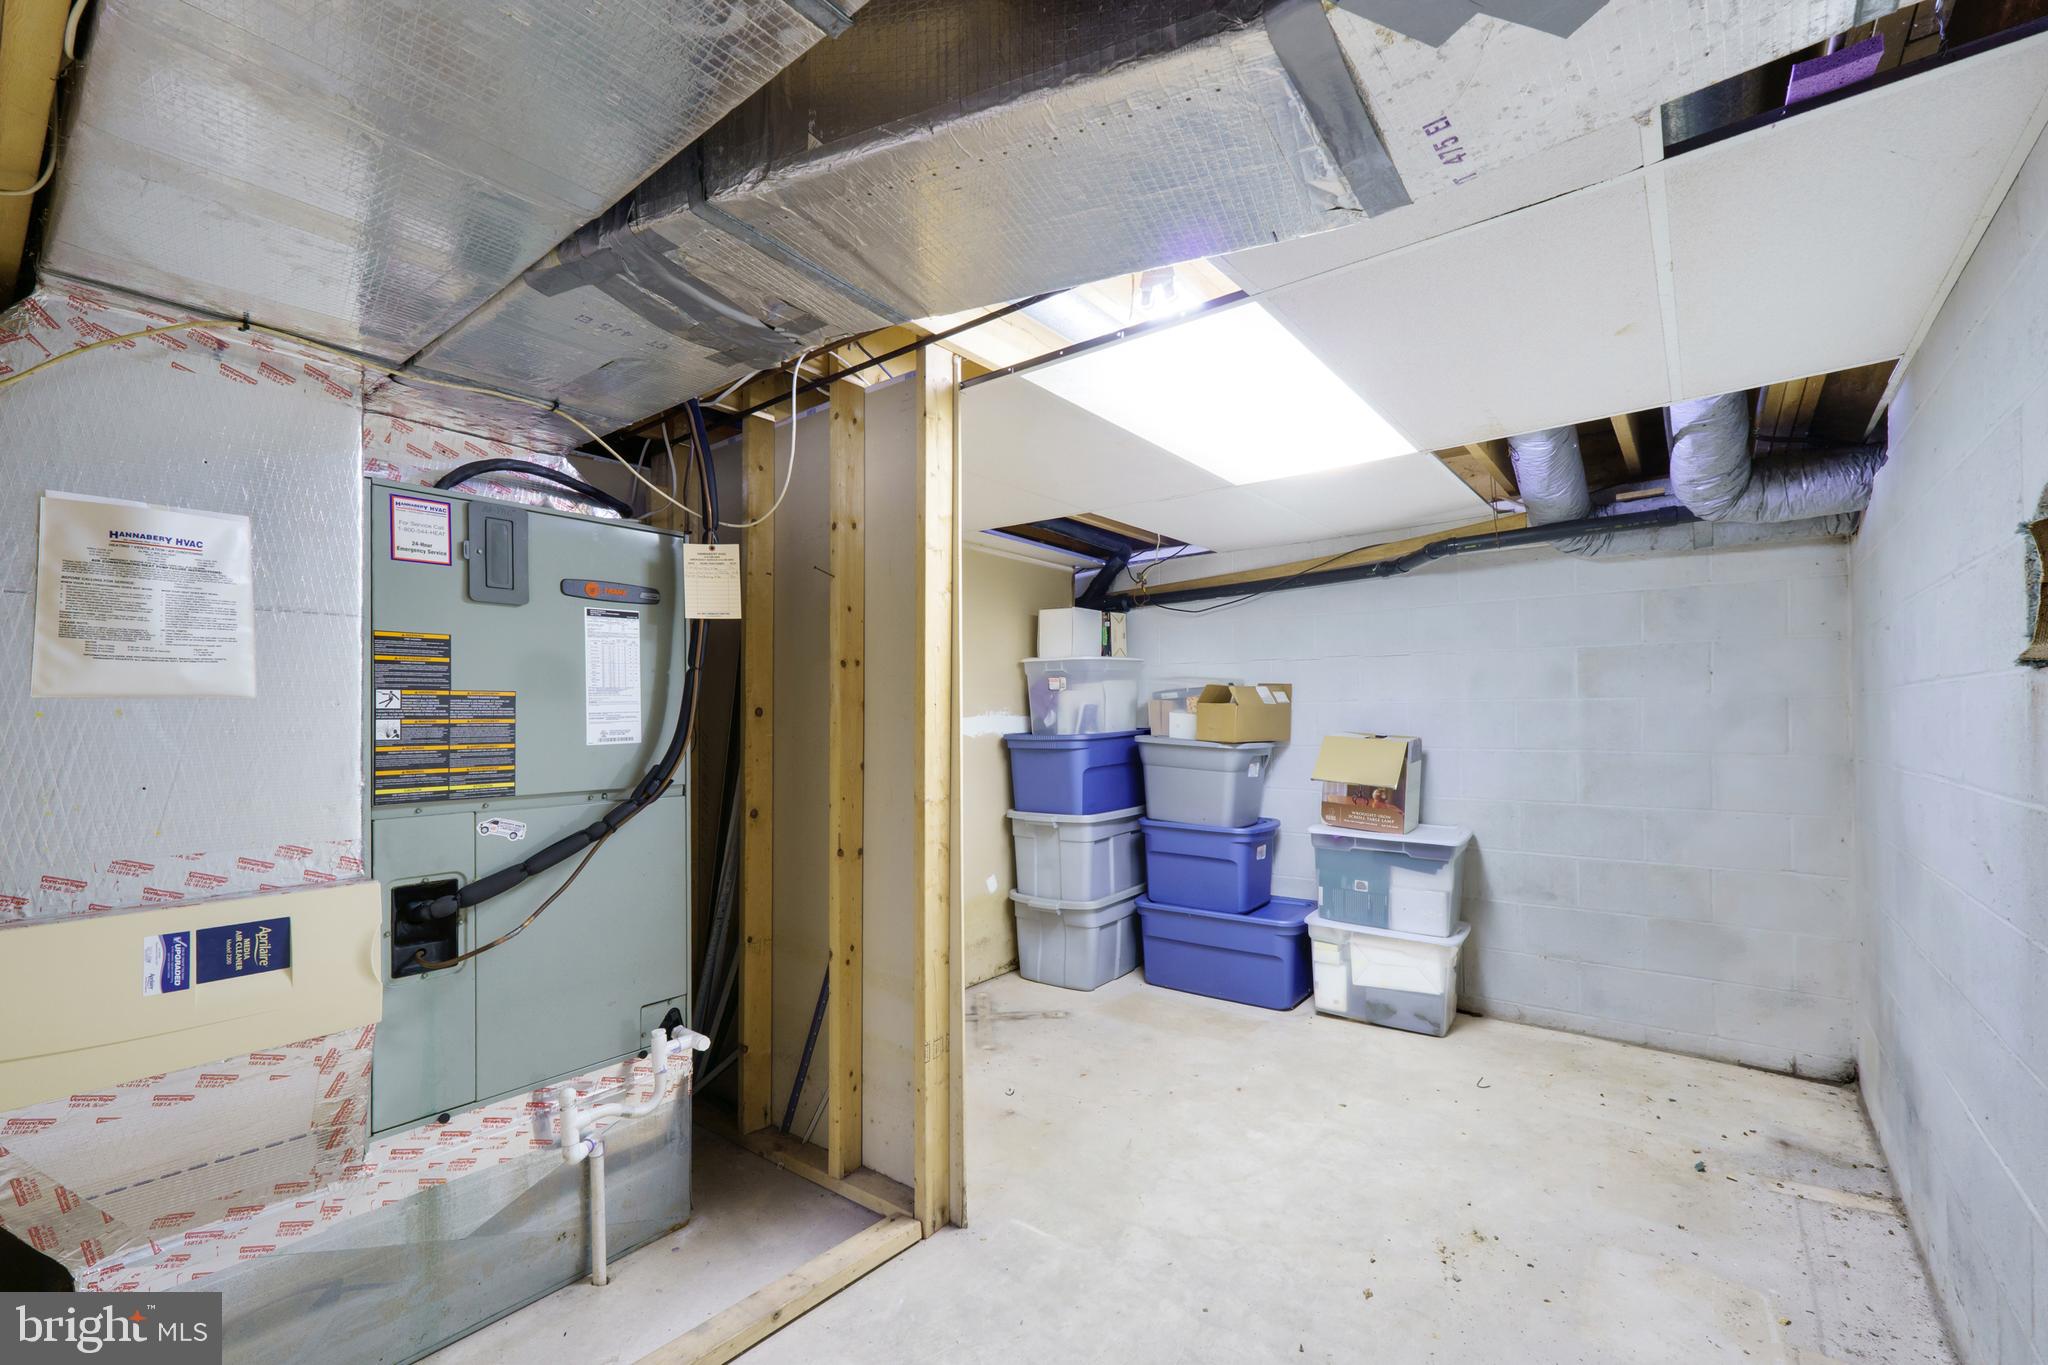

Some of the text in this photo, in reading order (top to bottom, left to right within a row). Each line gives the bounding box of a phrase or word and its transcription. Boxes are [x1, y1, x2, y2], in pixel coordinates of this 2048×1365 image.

[1433, 136, 1467, 165] 475
[429, 506, 447, 514] HVAC
[411, 521, 432, 529] Service
[109, 530, 204, 549] HANNABERY HVAC
[396, 546, 426, 554] Emergency
[235, 930, 243, 971] AIR CLEANER
[243, 938, 251, 960] MEDIA
[255, 926, 272, 966] Aprilaire
[174, 943, 182, 986] UPGRADED
